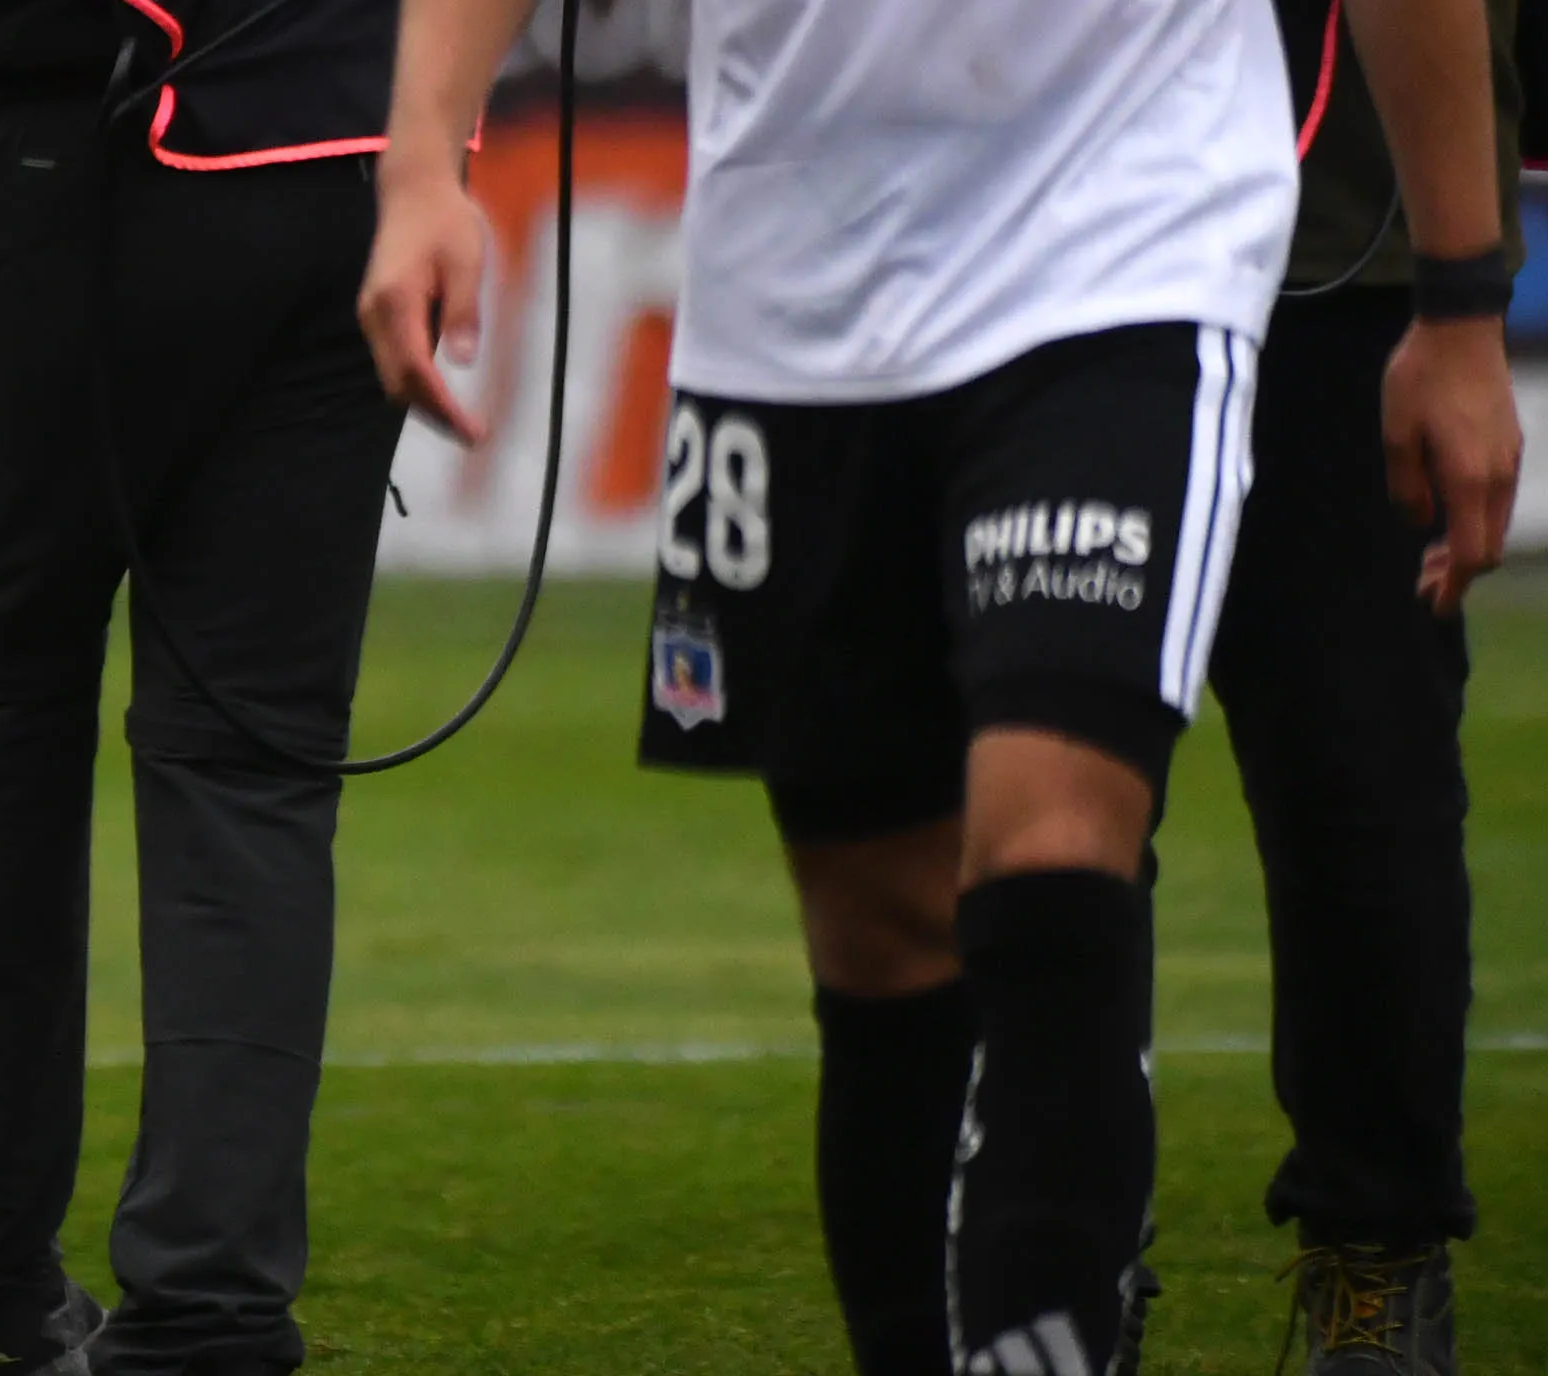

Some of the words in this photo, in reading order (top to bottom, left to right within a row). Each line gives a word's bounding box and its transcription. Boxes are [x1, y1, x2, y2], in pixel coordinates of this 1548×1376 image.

[659, 404, 770, 590] 28
[964, 500, 1152, 572] PHILIPS
[1021, 559, 1144, 611] Audio
